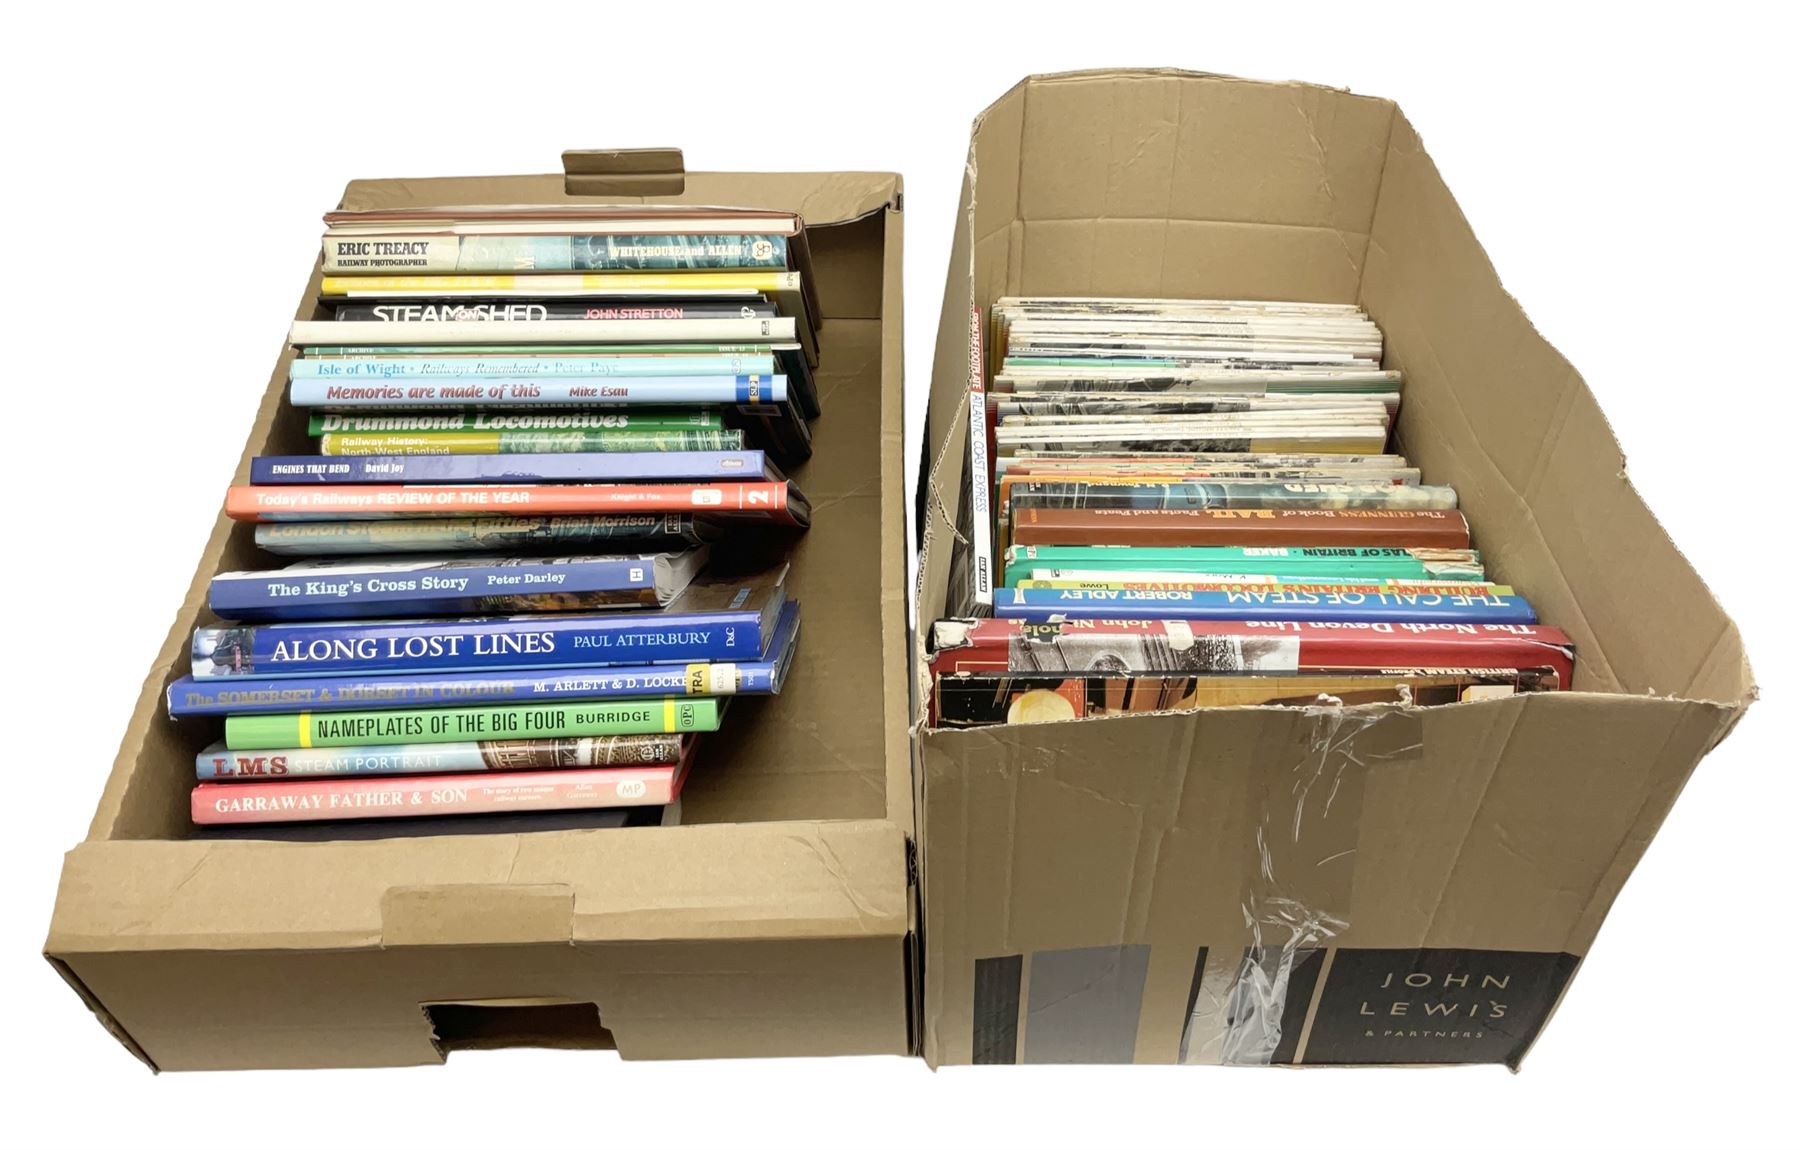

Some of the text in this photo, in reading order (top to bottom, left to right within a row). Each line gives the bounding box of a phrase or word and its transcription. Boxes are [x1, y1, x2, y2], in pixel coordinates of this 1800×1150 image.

[337, 242, 429, 256] ERIC TREACY
[608, 245, 681, 259] WHITEHOUSE
[708, 244, 742, 256] ALLEN
[337, 258, 428, 267] RAILWAY PHOTOGRAPHER
[373, 304, 547, 322] STEAM ON SHED
[584, 308, 684, 319] JOHN STRETTON
[318, 364, 344, 375] Isle
[346, 363, 363, 375] of
[366, 363, 405, 377] Wight
[420, 363, 470, 378] Railways
[475, 362, 540, 375] Remembered
[554, 362, 584, 374] Peter
[971, 347, 982, 390] FOOTPLATE
[327, 383, 629, 400] Memories are made of this Mike Esau
[321, 412, 628, 431] Drummond Locomotives
[341, 436, 382, 447] Railway
[971, 394, 988, 513] ATLANTIC COAST EXPRESS
[272, 463, 405, 474] ENGINES THAT BEND David Joy
[256, 493, 308, 507] Today's
[313, 492, 372, 506] Railways
[377, 492, 435, 504] REVIEW
[437, 492, 457, 504] OF
[460, 492, 489, 504] THE
[493, 491, 530, 503] YEAR
[748, 490, 769, 504] 2
[1132, 509, 1159, 517] and
[1160, 509, 1199, 517] Facts
[1282, 509, 1300, 518] of
[1300, 509, 1336, 518] Book
[1338, 509, 1415, 519] GUINNESS
[1416, 510, 1445, 519] The
[550, 516, 591, 529] Brian
[593, 514, 656, 528] Morrison
[1242, 547, 1410, 558] LAS OF BRITAIN BAKER
[268, 572, 566, 598] The King's Cross Story Peter Darley
[1123, 582, 1275, 594] LOCOMOTIVES
[1282, 584, 1382, 595] BRITAIN'S
[1388, 585, 1489, 596] BUILDING
[1060, 589, 1510, 606] THE CALL OF STEAM ROBERT ADLEY
[1101, 618, 1153, 630] John
[1246, 619, 1536, 635] The North Devon Line
[270, 626, 736, 662] ALONG LOST LINES PAUL ATTERBURY D&C
[185, 692, 213, 707] The
[216, 688, 316, 706] SOMERSET
[319, 687, 333, 701] &
[337, 685, 411, 700] DORSET
[414, 684, 434, 699] IN
[439, 682, 515, 699] COLOUR
[533, 681, 549, 693] M.
[553, 677, 608, 692] ARLETT
[612, 677, 623, 689] &
[625, 677, 640, 689] D.
[318, 703, 693, 739] NAMEPLATES OF THE BIG FOUR BURRIDGE OPC
[212, 754, 441, 777] LMS STEAM PORTRAIT
[621, 783, 642, 794] MP
[214, 789, 467, 813] GARRAWAY FATHER & SON
[1380, 972, 1511, 989] JOHN
[1359, 1000, 1509, 1018] LEWIS
[1384, 1029, 1484, 1039] PARTNERS
